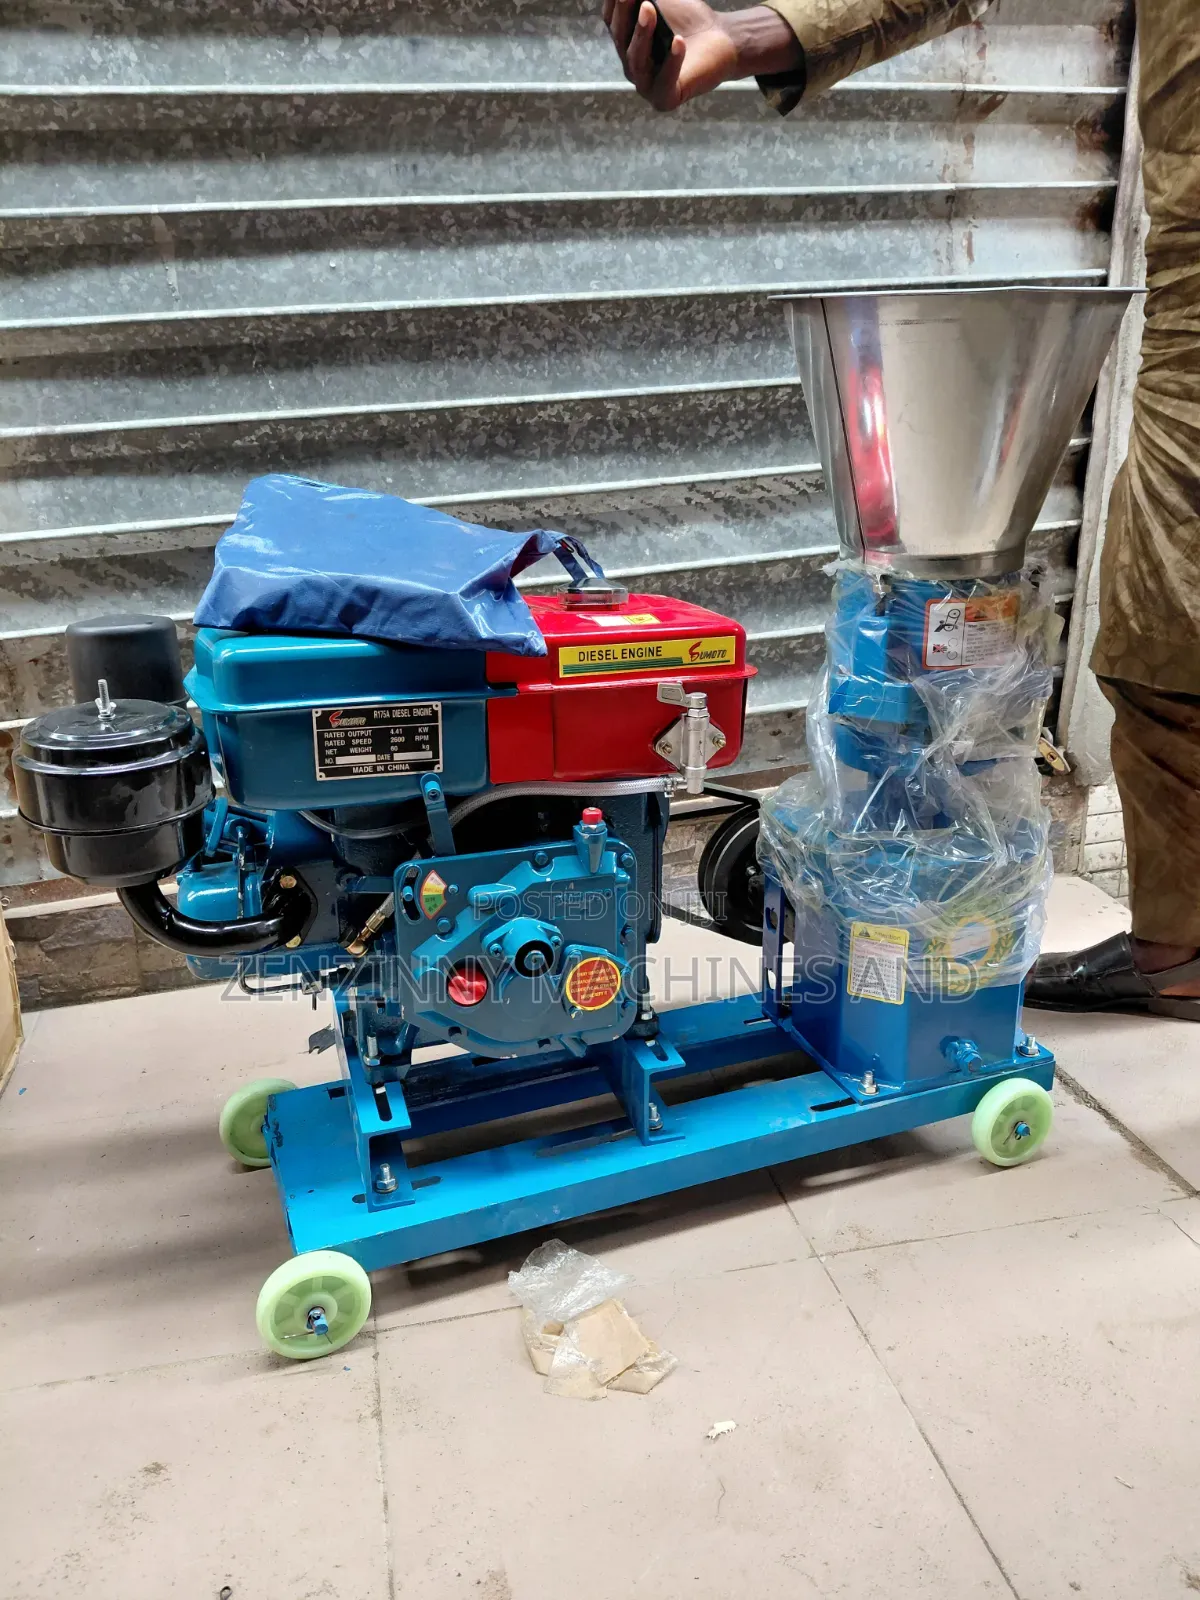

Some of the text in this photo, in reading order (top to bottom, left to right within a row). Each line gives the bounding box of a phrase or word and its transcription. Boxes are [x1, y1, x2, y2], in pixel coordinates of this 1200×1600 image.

[578, 646, 663, 662] DIESEL ENGINE
[373, 707, 432, 719] R175A DIESEL ENGINE
[325, 748, 337, 756] NET
[349, 746, 372, 754] WEIGHT
[421, 744, 430, 752] kg
[352, 766, 374, 774] MADE
[387, 763, 410, 771] CHINA
